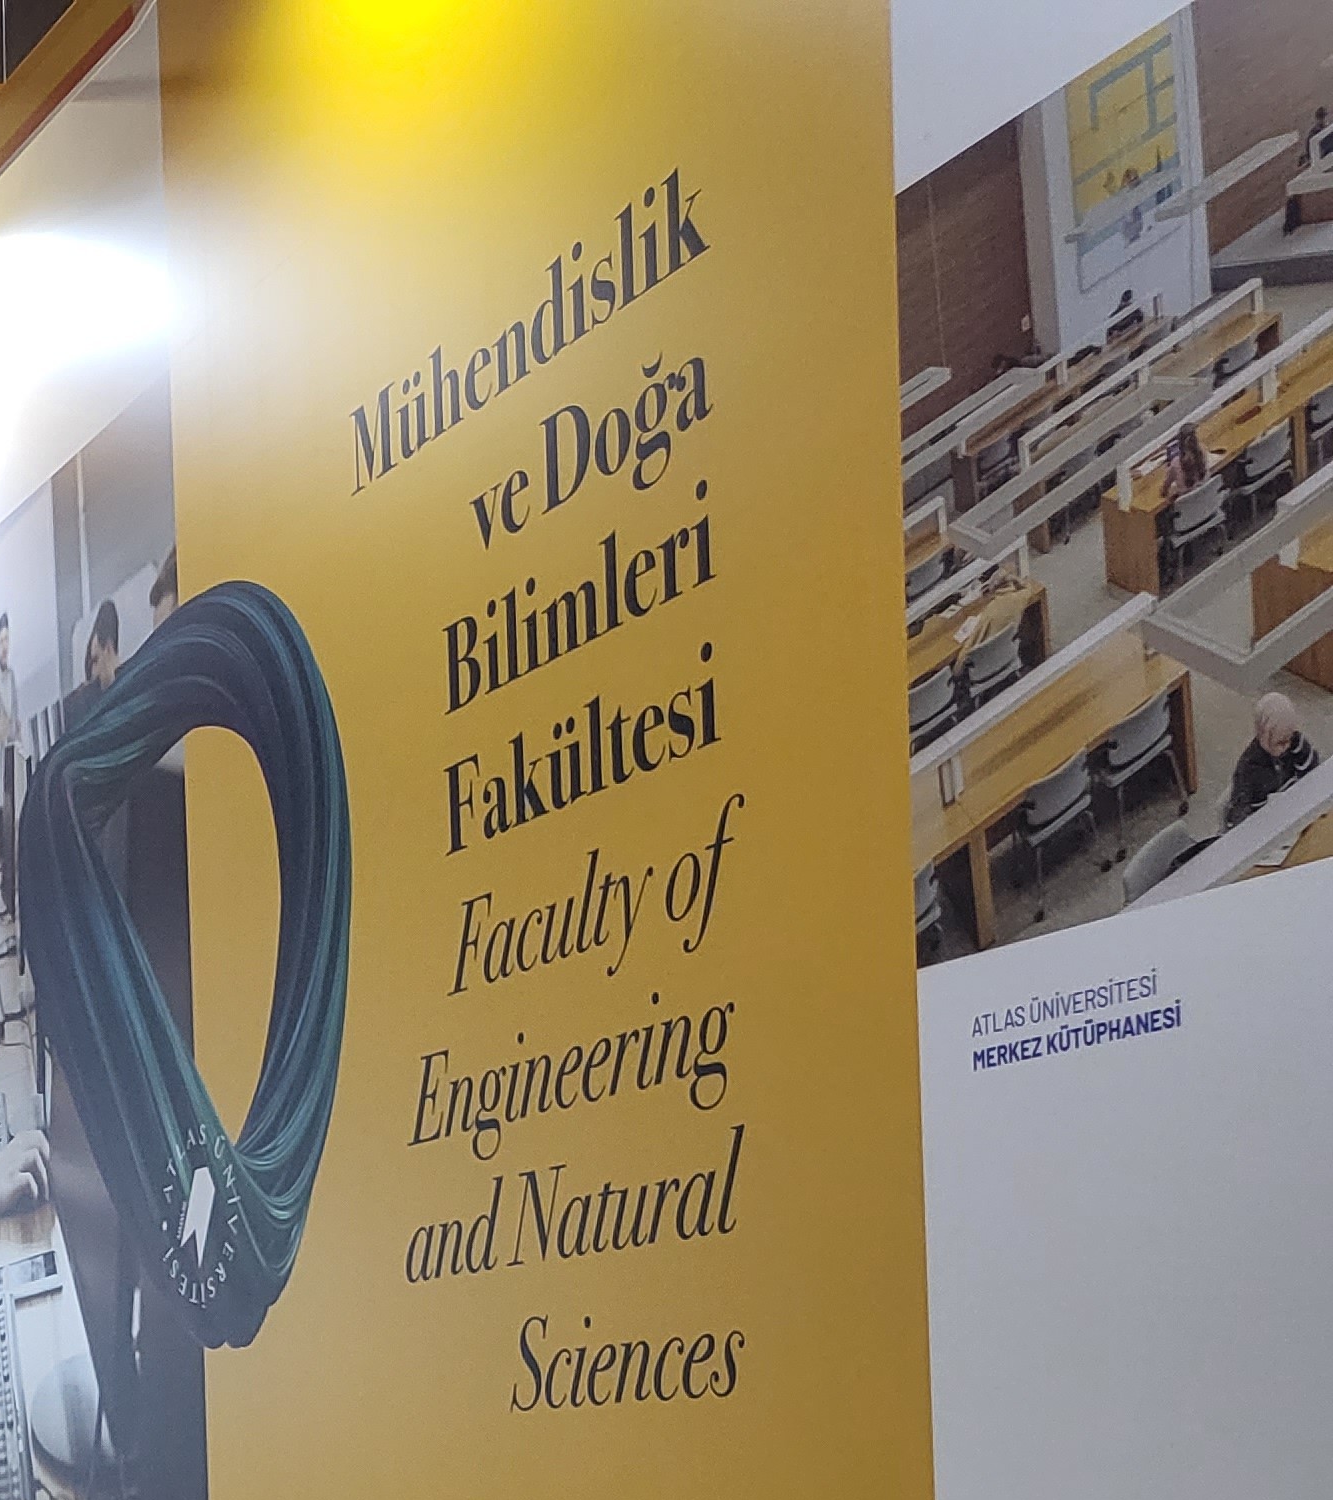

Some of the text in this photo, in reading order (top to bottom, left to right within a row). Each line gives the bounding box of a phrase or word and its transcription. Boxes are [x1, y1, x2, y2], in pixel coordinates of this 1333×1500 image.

[350, 167, 711, 496] Mühendislik
[469, 352, 714, 550] ve Doğa
[442, 479, 717, 715] Bilimleri
[444, 642, 722, 856] Fakültesi
[448, 793, 745, 996] Faculty of
[407, 991, 736, 1161] Engineering
[972, 967, 1158, 1037] ATLAS ÜNİVERSİTESİ
[972, 998, 1182, 1072] MERKEZ KÜTÜPHANESİ
[405, 1123, 746, 1285] and Natural
[510, 1315, 746, 1414] Sciences
